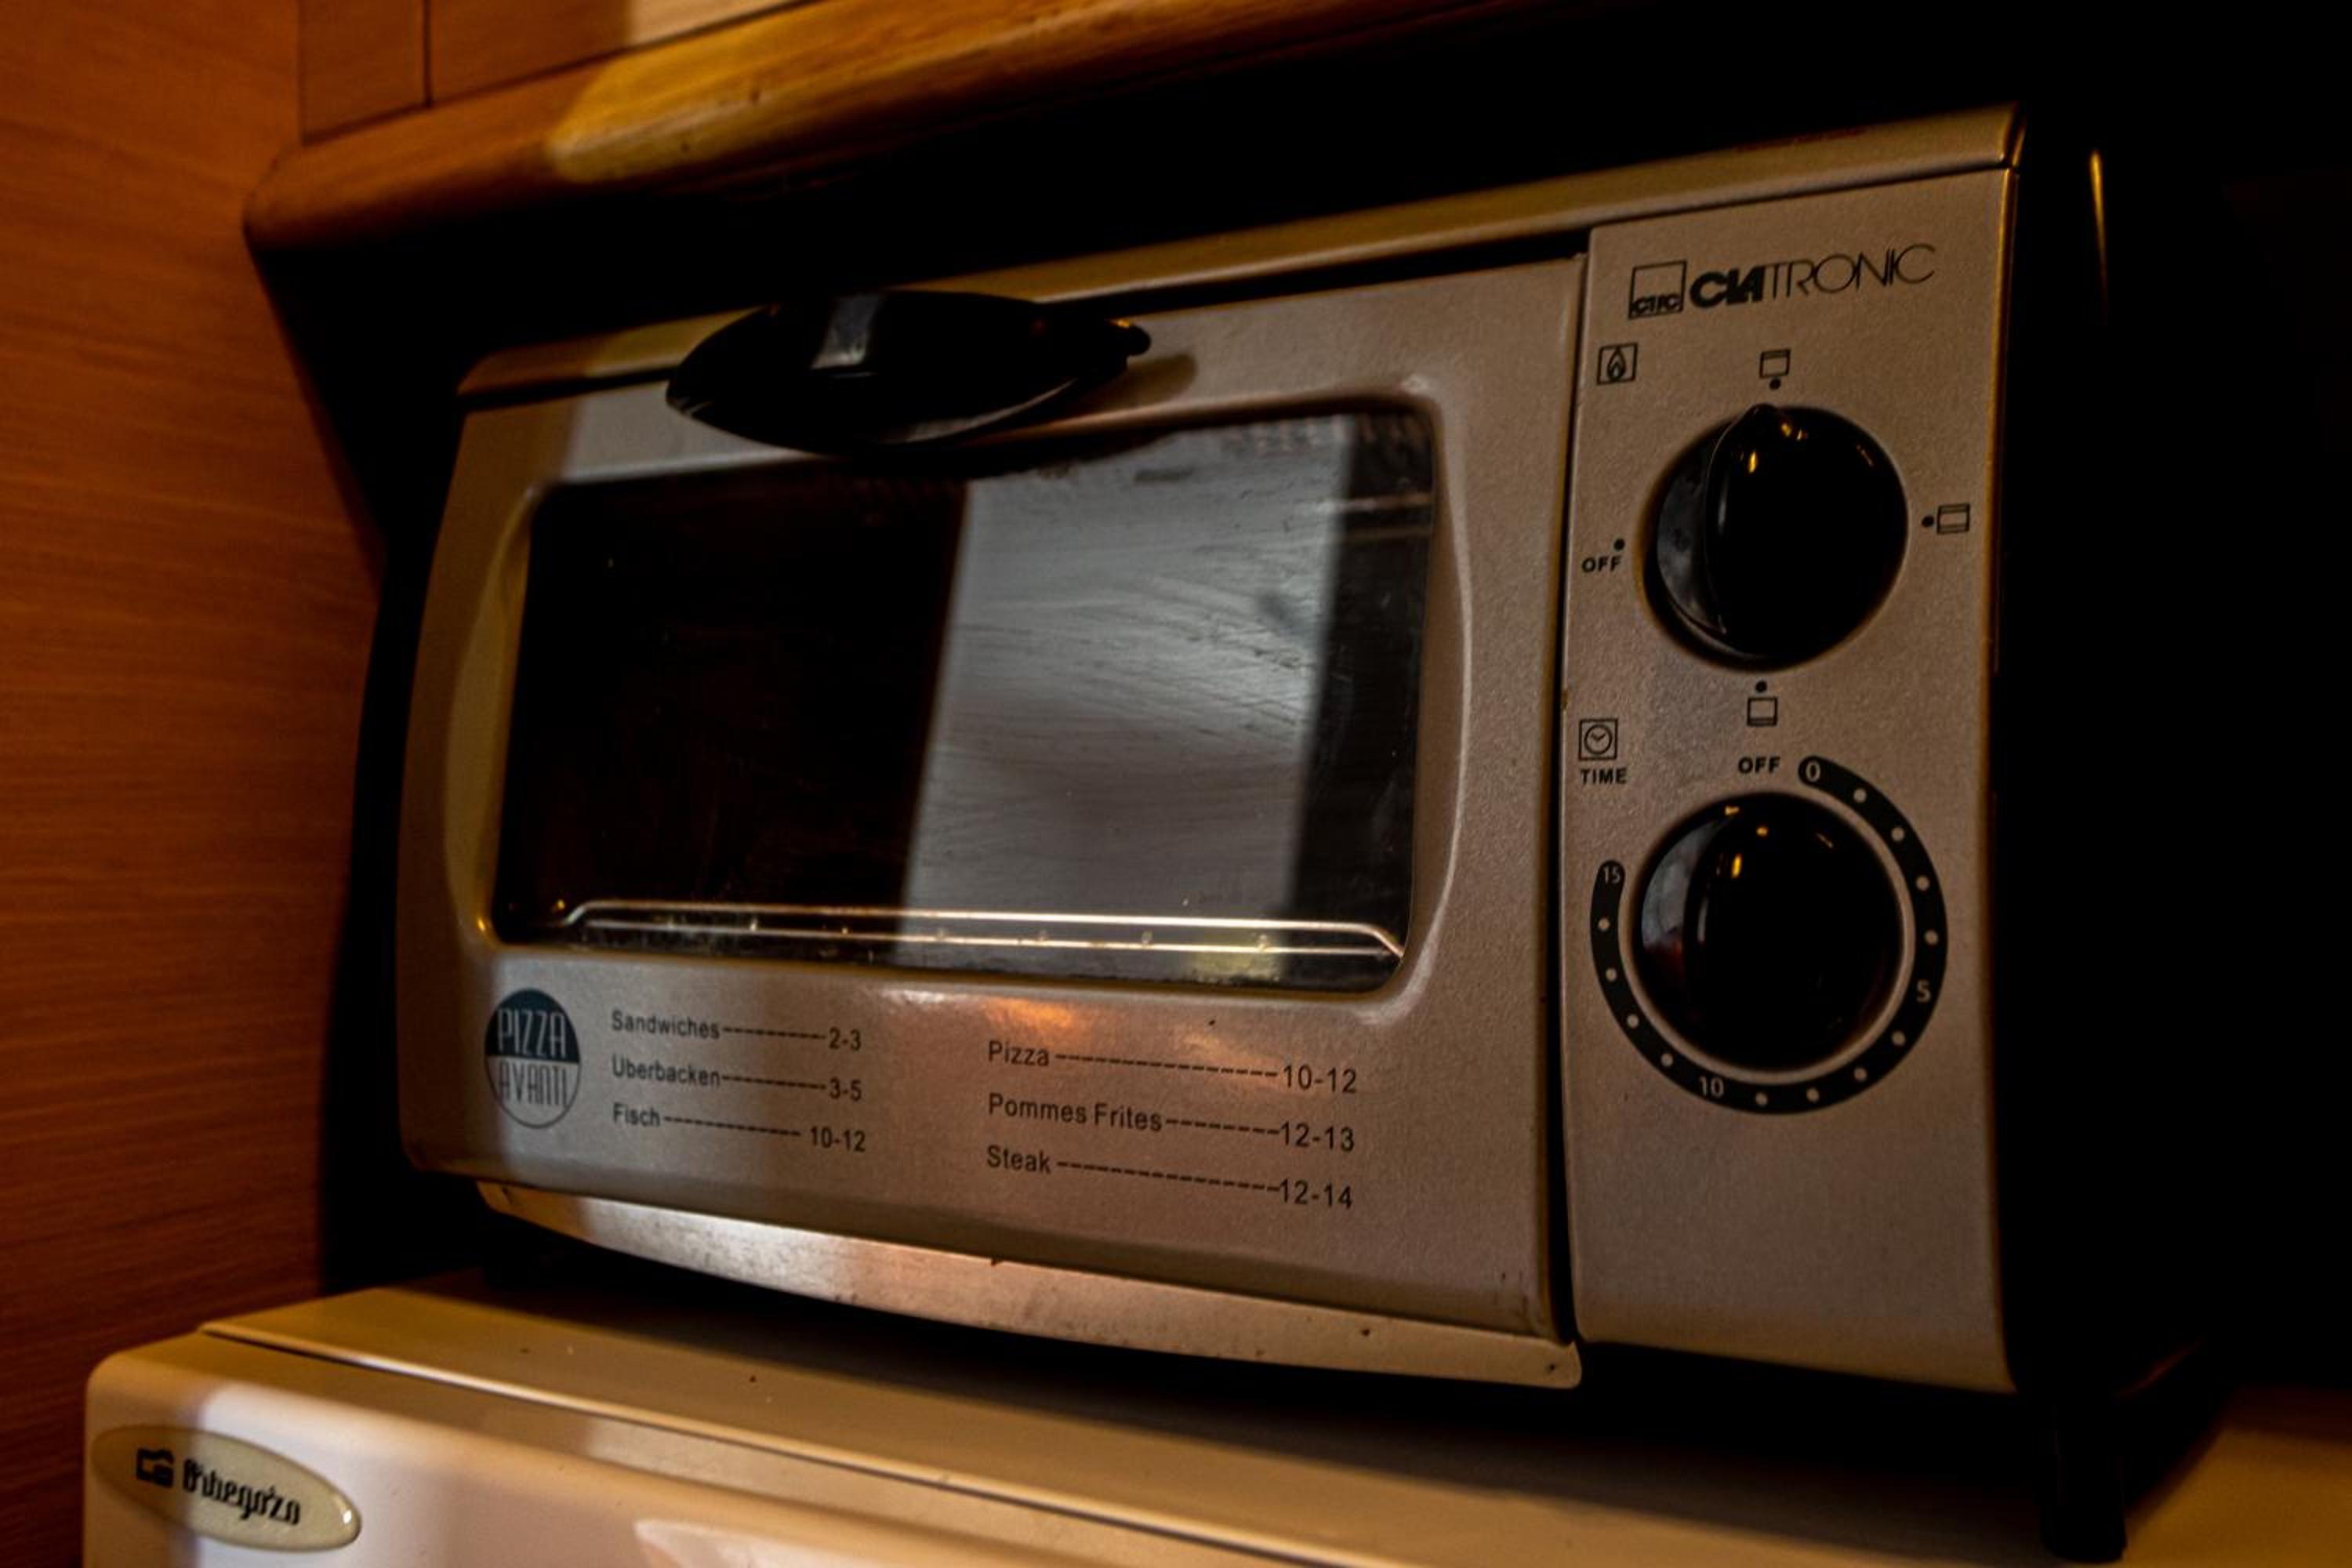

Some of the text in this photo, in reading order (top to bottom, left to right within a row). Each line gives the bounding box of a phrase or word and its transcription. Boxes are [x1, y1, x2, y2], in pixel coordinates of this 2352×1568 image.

[1581, 556, 1622, 573] OFF
[1581, 768, 1627, 784] TIME
[1737, 757, 1780, 775] OFF
[1806, 764, 1820, 782] 0
[1602, 867, 1621, 884] 15
[1916, 980, 1931, 1002] 5
[497, 1007, 567, 1059] PIZZA
[612, 1009, 862, 1051] Sandwiches 2-3
[989, 1040, 1357, 1094] Pizza 10-12
[829, 1077, 862, 1101] 3-5
[1700, 1076, 1725, 1097] 10
[613, 1102, 866, 1152] Fisch 10-12
[989, 1092, 1356, 1152] Pommes Frites 12-13
[986, 1145, 1352, 1209] Steak 12-14
